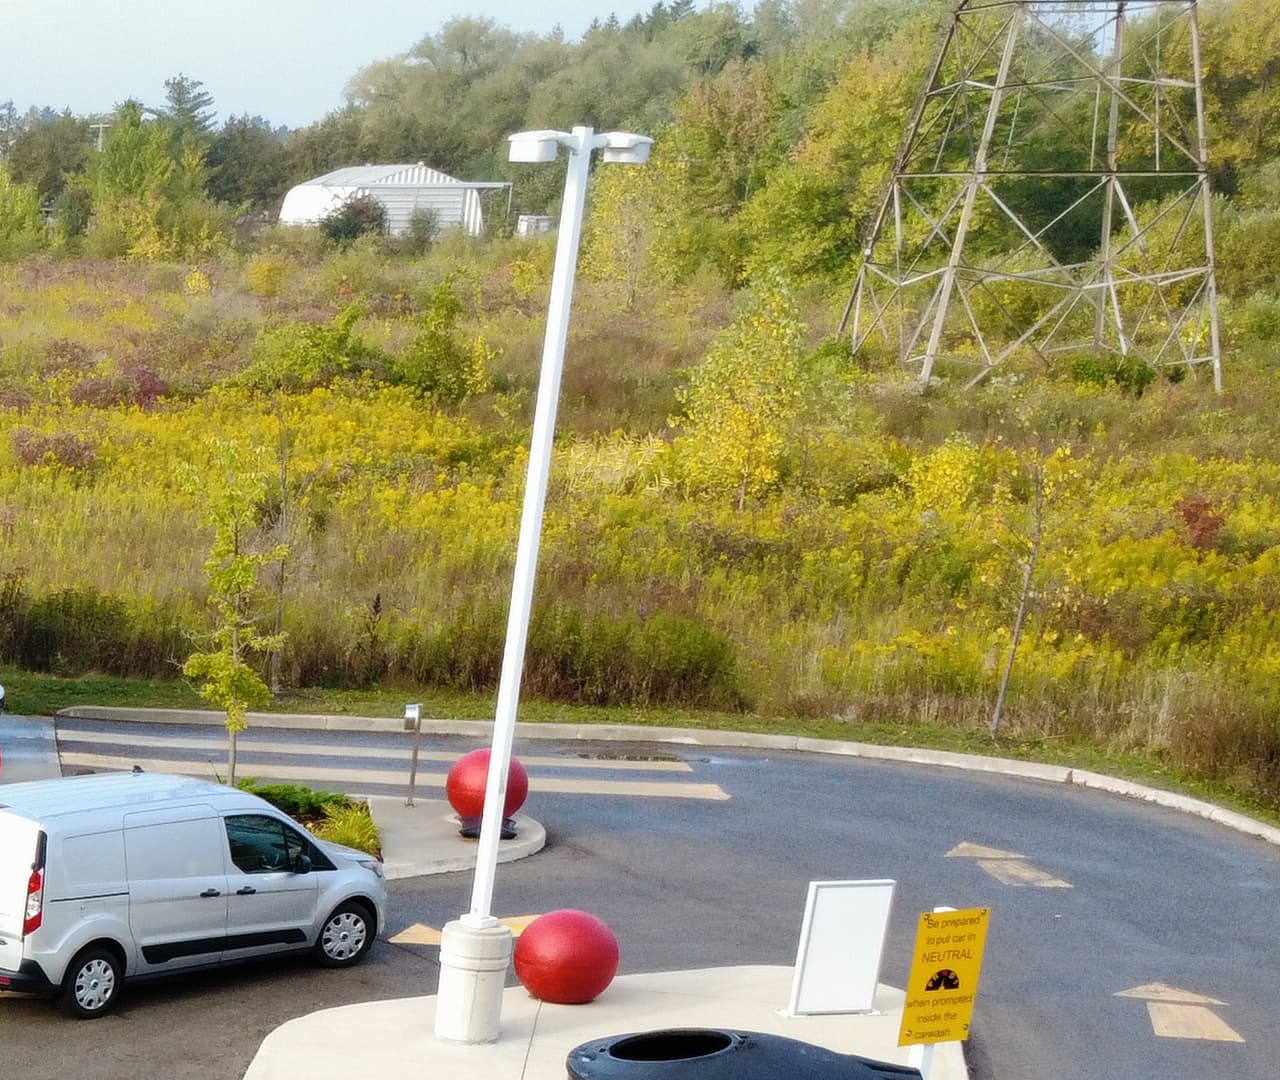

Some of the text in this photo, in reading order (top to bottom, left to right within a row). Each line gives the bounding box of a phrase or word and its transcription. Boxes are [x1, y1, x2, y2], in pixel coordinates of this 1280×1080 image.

[927, 917, 981, 929] Be prepared
[927, 936, 935, 945] to
[952, 935, 966, 943] car
[968, 932, 977, 941] in
[921, 949, 974, 964] NEUTRAL
[906, 995, 973, 1008] when prompted
[915, 1012, 958, 1023] inside the
